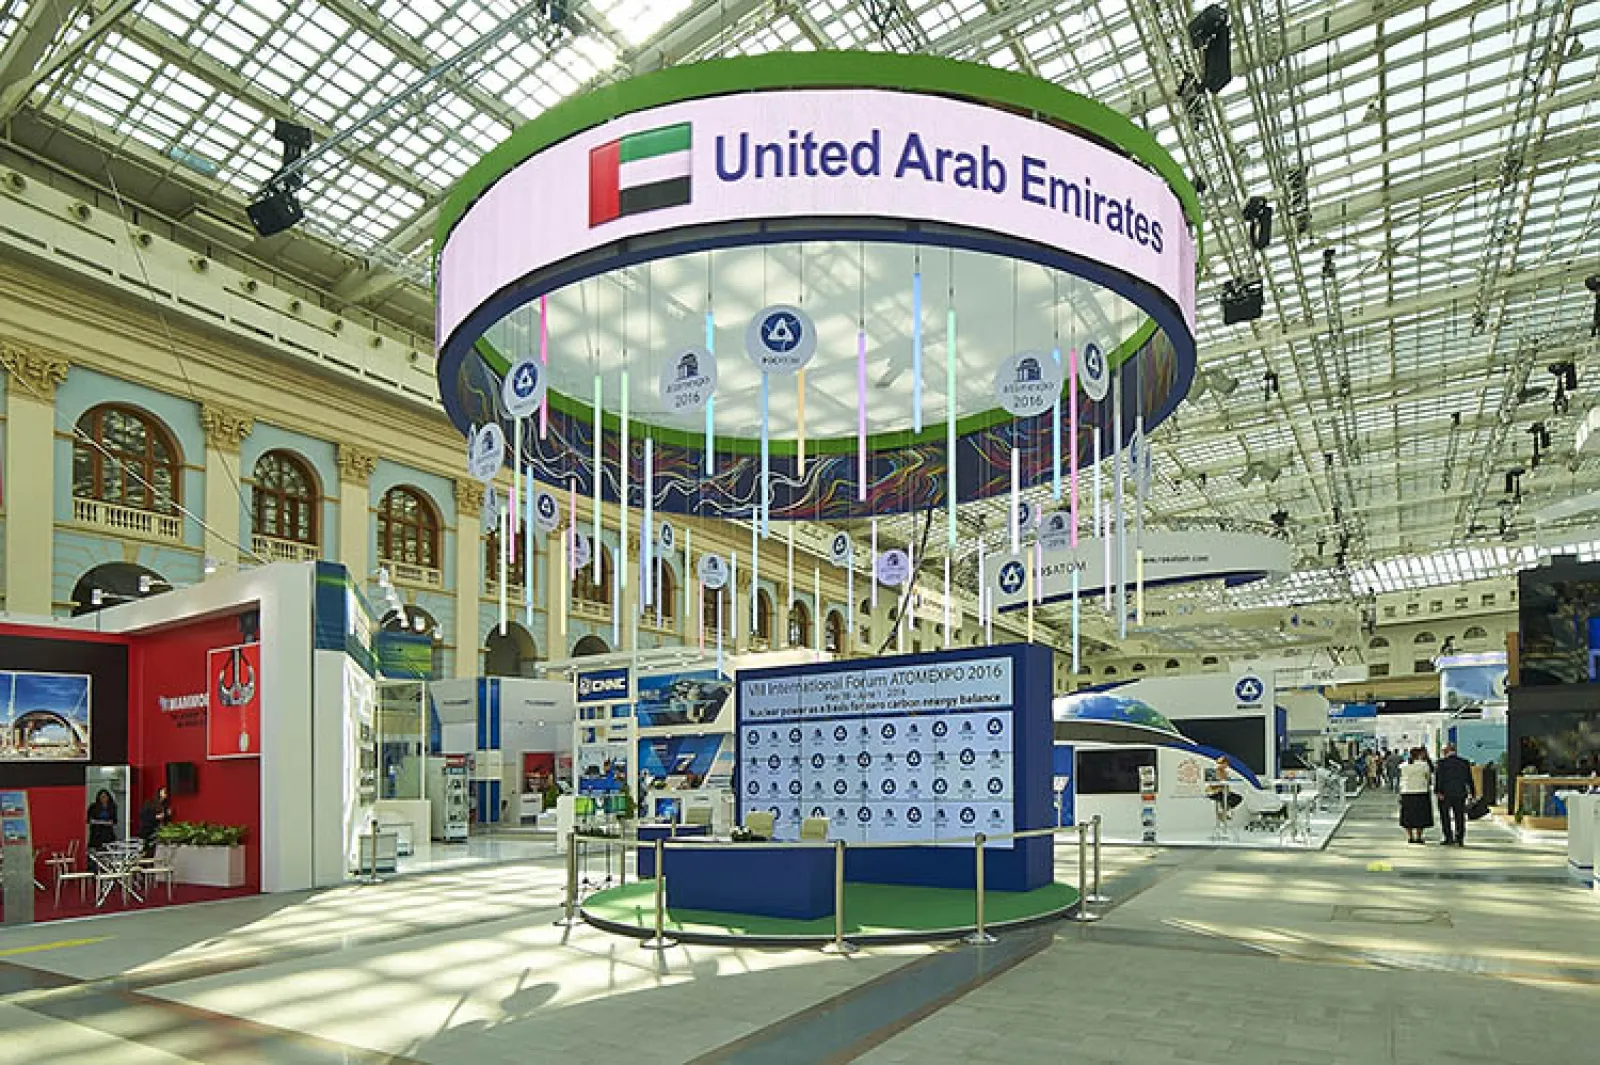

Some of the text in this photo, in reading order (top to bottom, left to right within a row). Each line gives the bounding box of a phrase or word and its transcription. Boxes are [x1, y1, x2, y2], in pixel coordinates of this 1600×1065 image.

[714, 128, 1164, 254] United Arab Emirates
[675, 391, 701, 408] 2016
[1013, 394, 1044, 408] 2016
[768, 676, 844, 695] International
[846, 674, 888, 690] Forum
[890, 667, 965, 685] ATOMEXPO
[967, 665, 1003, 680] 2016
[780, 706, 807, 718] power
[850, 701, 864, 712] for
[887, 698, 921, 709] carbon
[923, 696, 958, 708] energy
[959, 692, 1001, 705] balance
